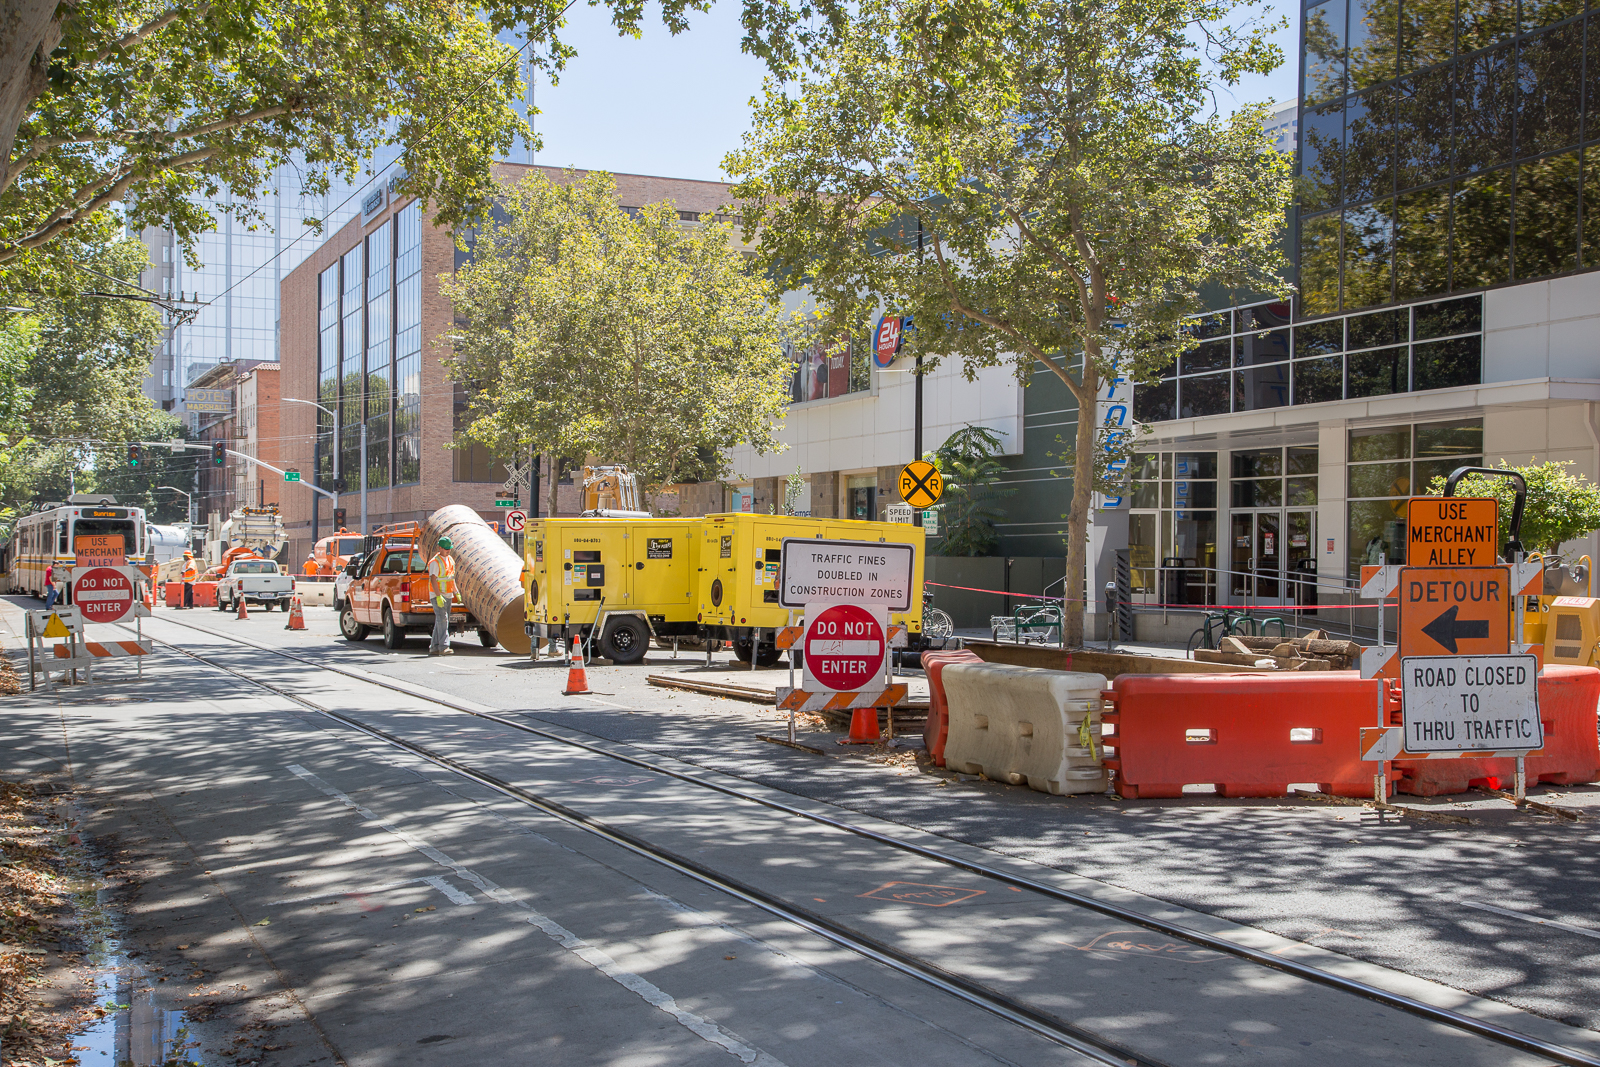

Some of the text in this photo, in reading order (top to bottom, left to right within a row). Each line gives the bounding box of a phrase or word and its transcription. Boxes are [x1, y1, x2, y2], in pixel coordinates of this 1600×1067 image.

[880, 321, 898, 348] 24
[878, 341, 893, 351] HOUR
[187, 391, 229, 402] HOTEL
[186, 403, 229, 412] MARSHALL
[903, 478, 939, 490] R R
[1438, 503, 1467, 520] USE
[1411, 525, 1494, 543] MERCHANT
[91, 538, 108, 546] USE
[77, 547, 122, 557] MERCHANT
[1428, 548, 1476, 565] ALLEY
[87, 558, 114, 567] ALLEY
[811, 553, 886, 565] TRAFFIC FINES
[817, 570, 878, 581] DOUBLED IN
[82, 578, 124, 588] DO NOT
[790, 585, 903, 599] CONSTRUCTION ZONES
[1409, 581, 1500, 602] DETOUR
[86, 603, 121, 613] ENTER
[817, 621, 874, 635] DO NOT
[821, 660, 867, 674] ENTER
[1414, 666, 1526, 687] ROAD CLOSED
[1460, 693, 1479, 713] TO
[1413, 719, 1532, 741] THRU TRAFFIC
